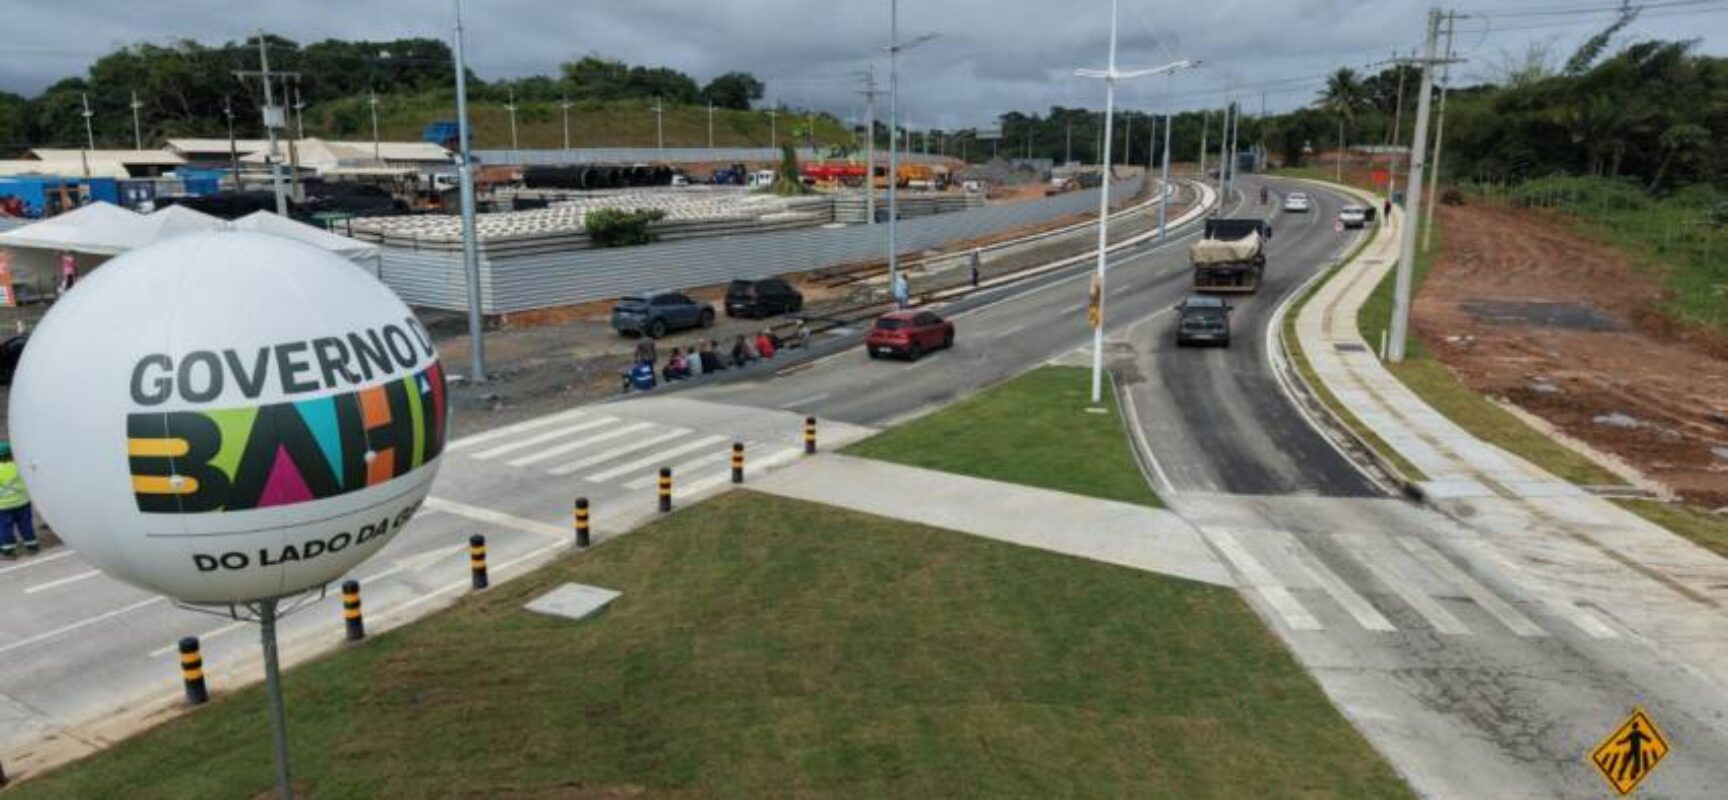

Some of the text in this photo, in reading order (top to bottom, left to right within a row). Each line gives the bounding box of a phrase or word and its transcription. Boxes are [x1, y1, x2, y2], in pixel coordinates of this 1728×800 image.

[129, 324, 417, 406] GOVERNO
[127, 359, 446, 514] BAHI
[193, 517, 389, 572] DO LADO DA
